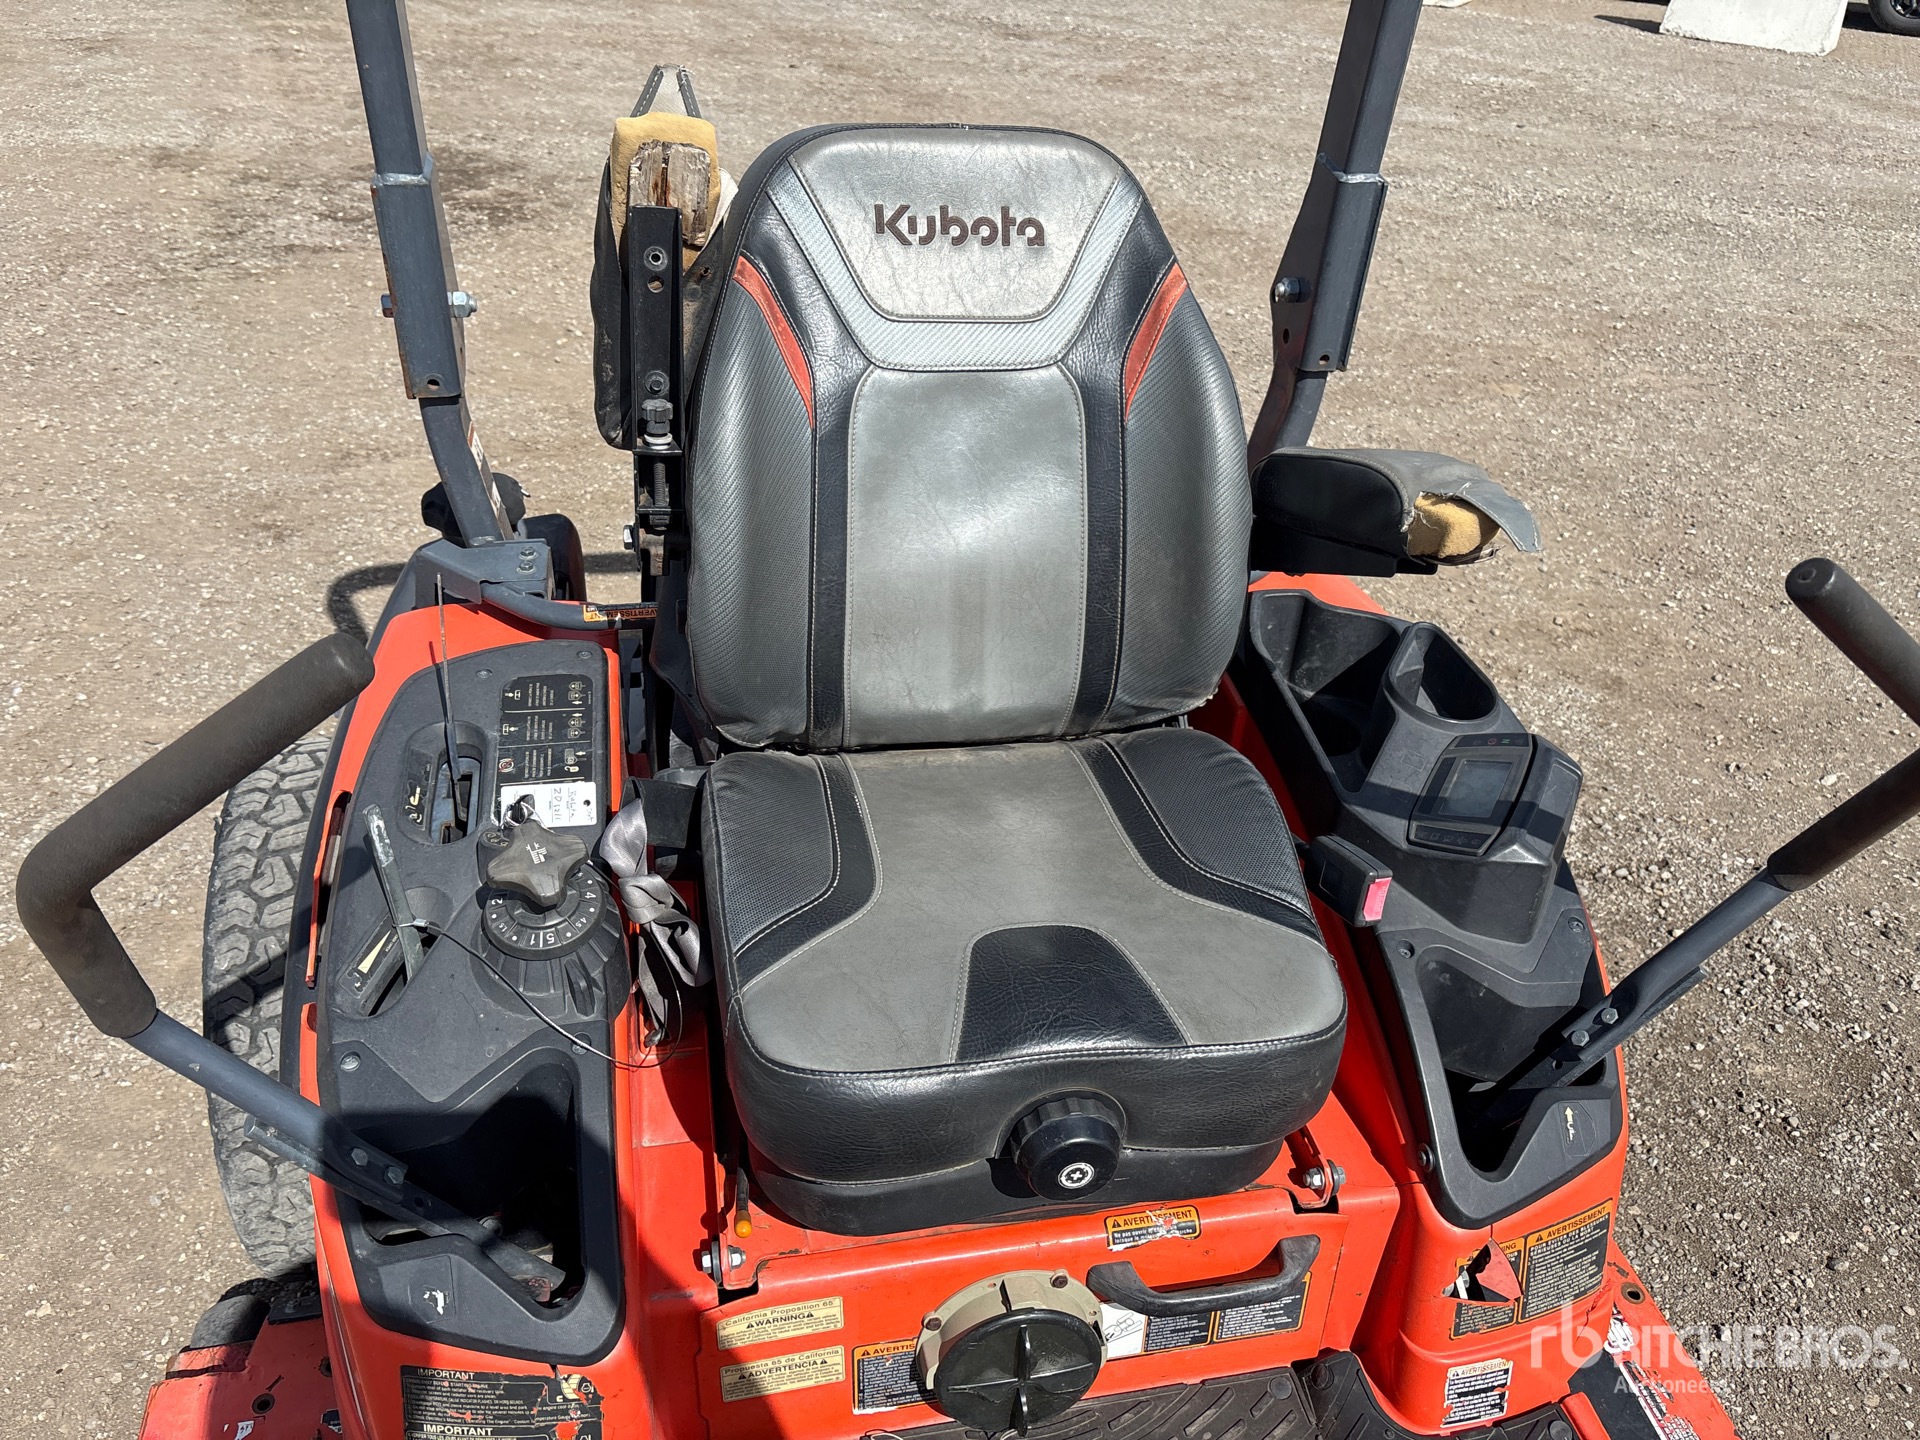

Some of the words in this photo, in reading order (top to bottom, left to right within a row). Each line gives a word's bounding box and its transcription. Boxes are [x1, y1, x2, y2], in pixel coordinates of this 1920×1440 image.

[874, 204, 1045, 246] Kubota
[546, 932, 555, 944] 5
[1546, 1206, 1607, 1239] AVERTISSEMENT
[725, 1312, 768, 1326] California
[771, 1303, 820, 1317] Proposition
[755, 1313, 806, 1327] WARNING
[725, 1362, 768, 1374] Propuesta
[798, 1349, 839, 1360] California
[748, 1360, 818, 1378] ADVERTENCIA
[418, 1369, 475, 1380] IMPORTANT
[423, 1425, 493, 1436] IMPORTANT
